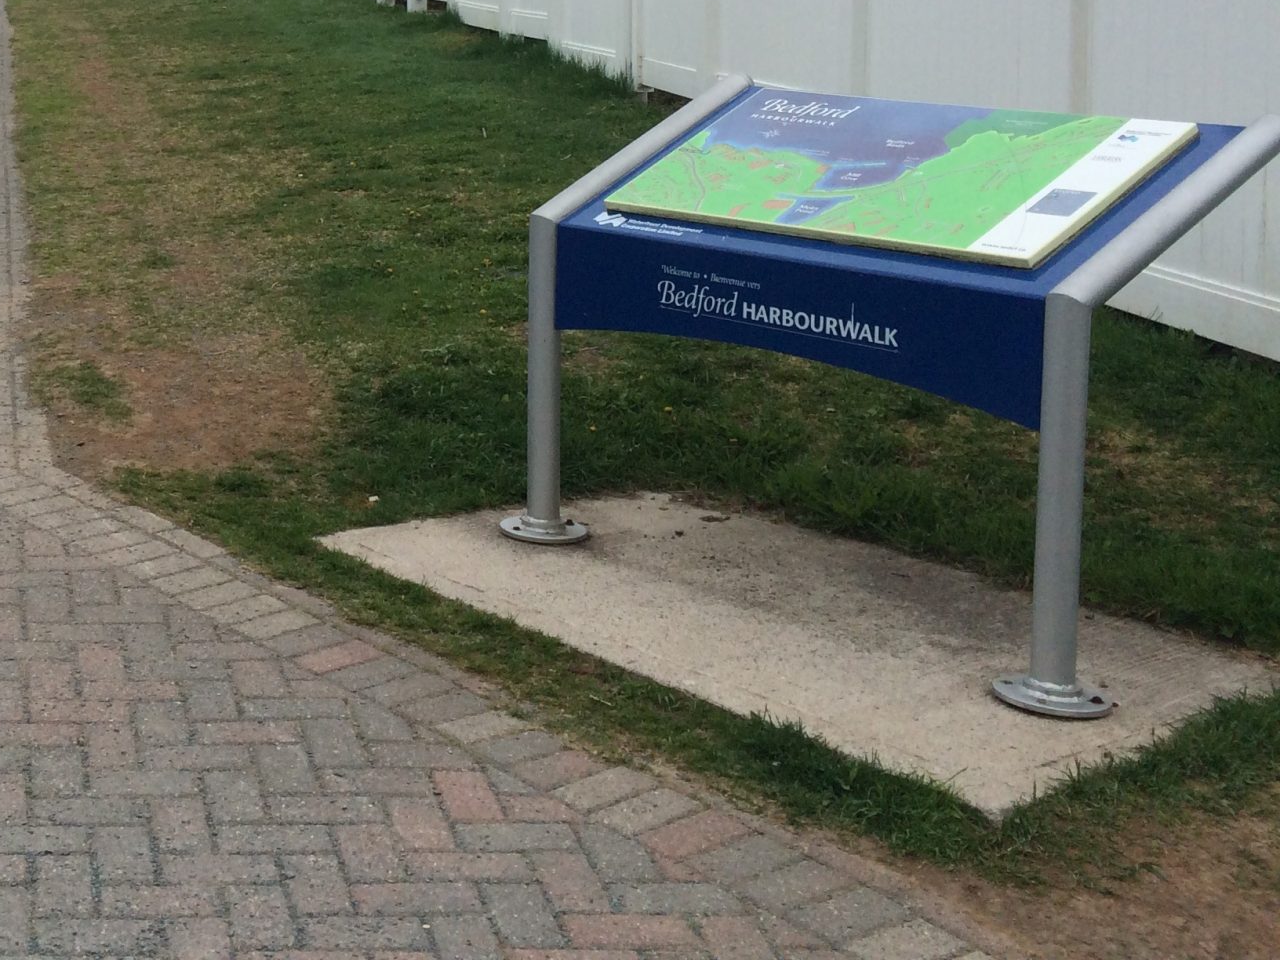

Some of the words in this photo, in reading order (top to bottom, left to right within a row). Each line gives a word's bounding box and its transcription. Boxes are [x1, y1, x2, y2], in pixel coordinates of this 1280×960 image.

[760, 98, 861, 119] Bedford
[661, 264, 693, 279] Welcome
[657, 280, 739, 318] Bedford
[742, 301, 899, 348] HARBOURWALK
